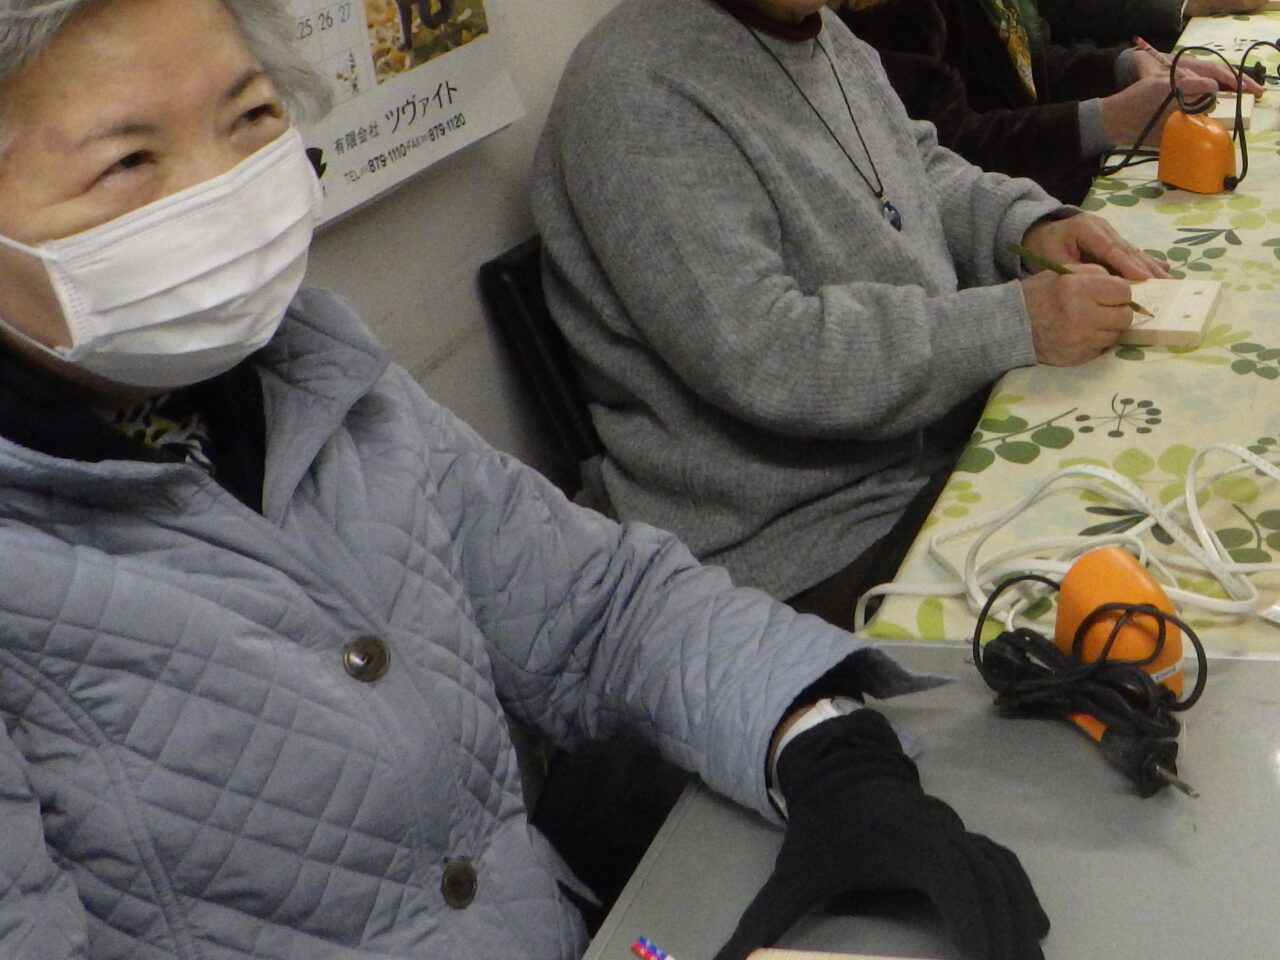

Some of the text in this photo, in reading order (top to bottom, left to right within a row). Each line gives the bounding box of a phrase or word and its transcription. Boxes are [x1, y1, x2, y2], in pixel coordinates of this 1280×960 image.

[297, 2, 352, 39] 25 26 27
[334, 80, 457, 156] 有限会社 ツヴァイト
